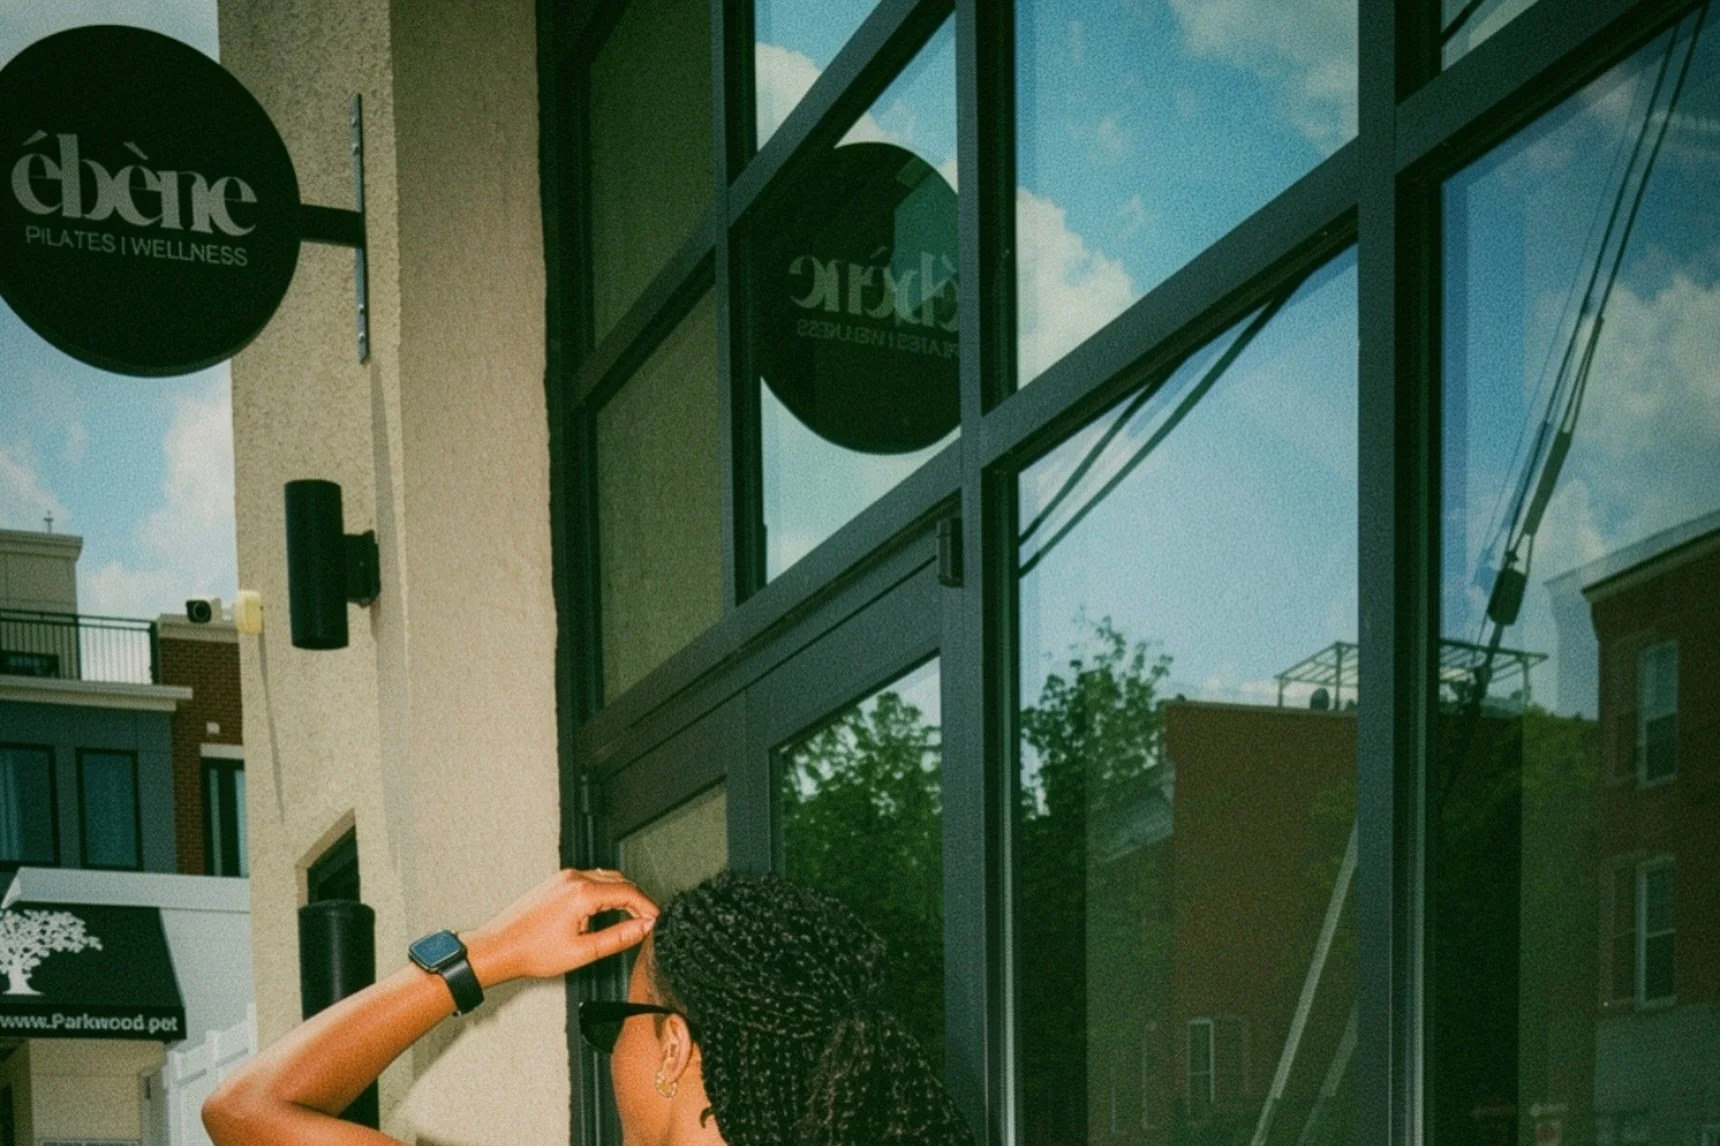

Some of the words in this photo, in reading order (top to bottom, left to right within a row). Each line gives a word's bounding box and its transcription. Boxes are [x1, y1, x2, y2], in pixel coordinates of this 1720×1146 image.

[11, 129, 258, 237] ébène
[25, 225, 116, 254] PILATES
[131, 237, 249, 268] WELLNESS
